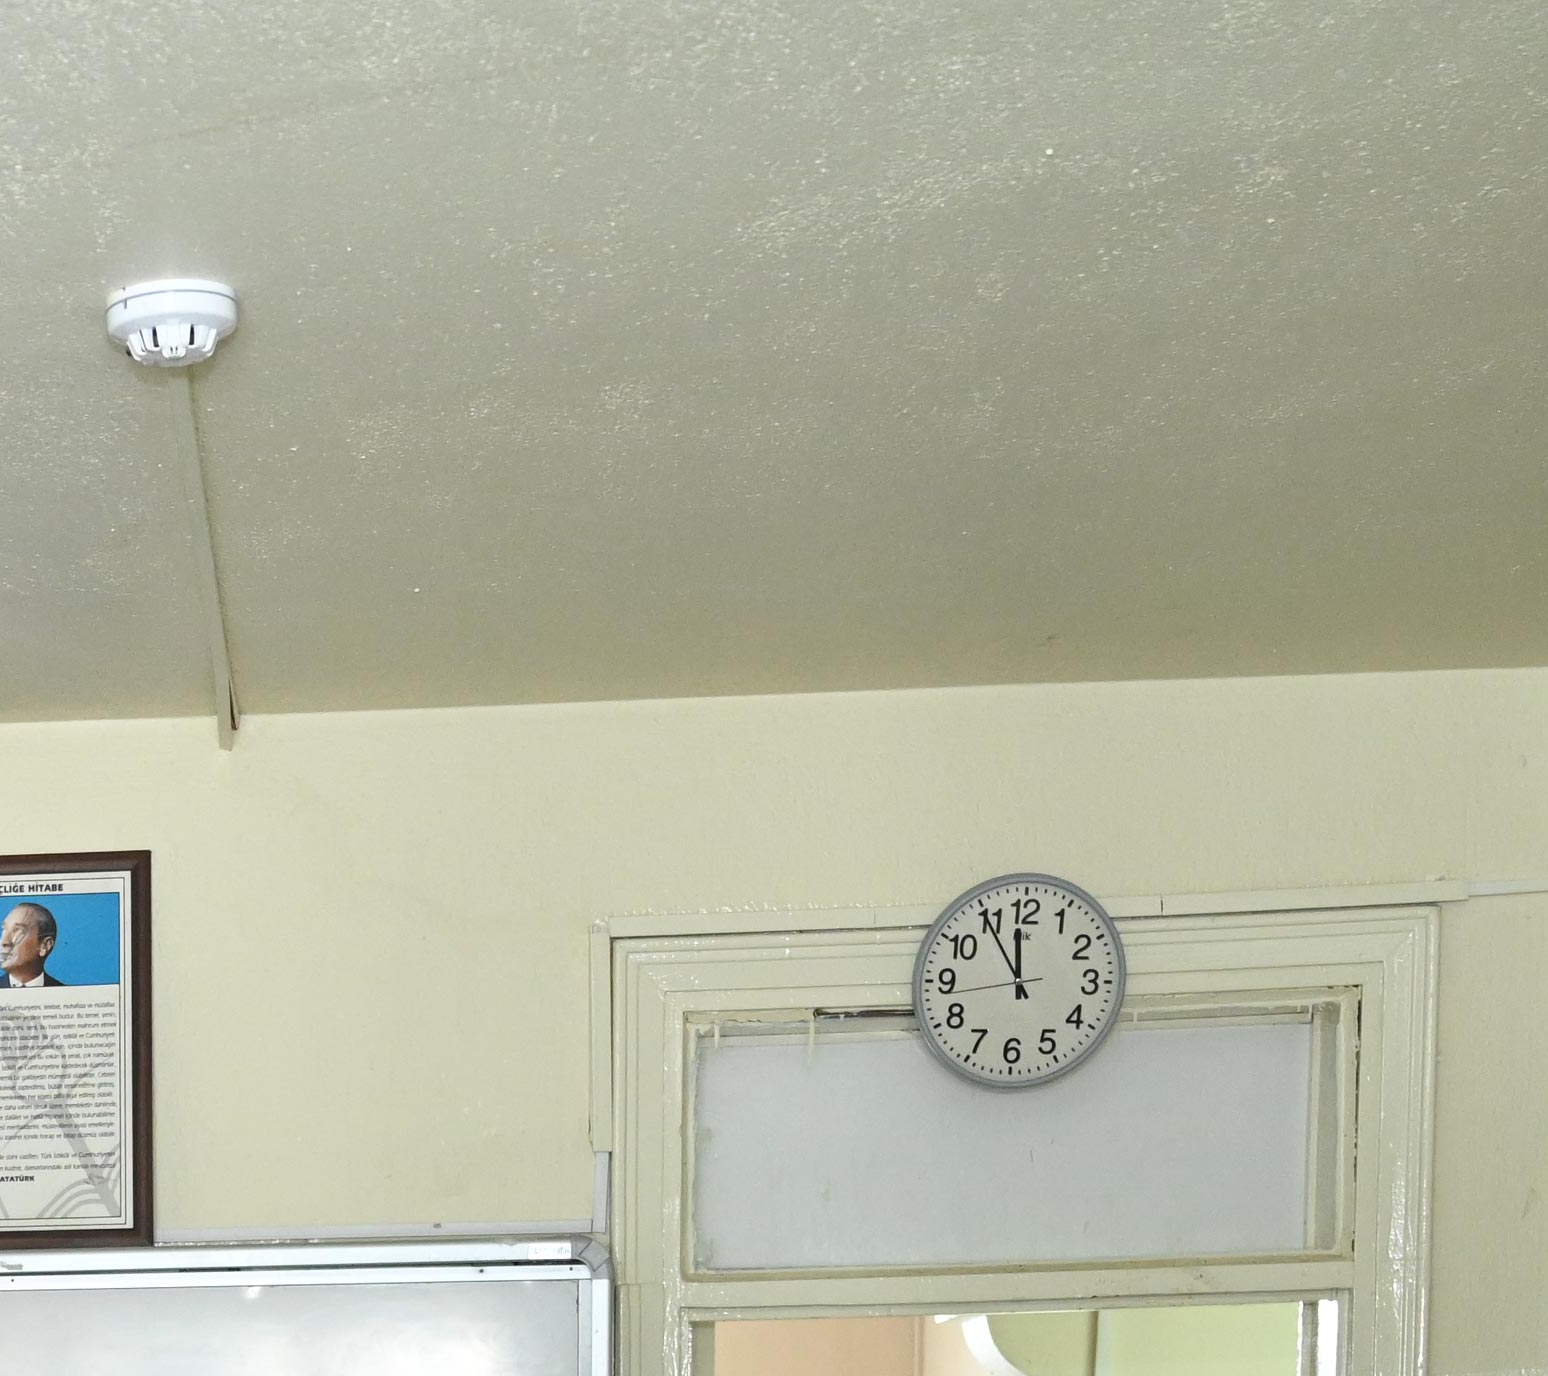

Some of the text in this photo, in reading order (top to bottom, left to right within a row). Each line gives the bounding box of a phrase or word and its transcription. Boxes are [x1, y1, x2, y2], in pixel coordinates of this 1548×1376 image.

[28, 881, 64, 892] HİTABE
[978, 908, 1003, 934] 11
[1011, 898, 1041, 925] 12
[1054, 908, 1065, 934] 1
[949, 934, 978, 960] 10
[1072, 934, 1091, 960] 2
[938, 968, 956, 994] 9
[1080, 969, 1099, 994] 3
[946, 1003, 964, 1028] 8
[1066, 1005, 1084, 1029] 4
[971, 1029, 988, 1054] 7
[1003, 1038, 1021, 1063] 6
[1038, 1029, 1056, 1054] 5
[0, 1174, 35, 1183] ATATÜRK
